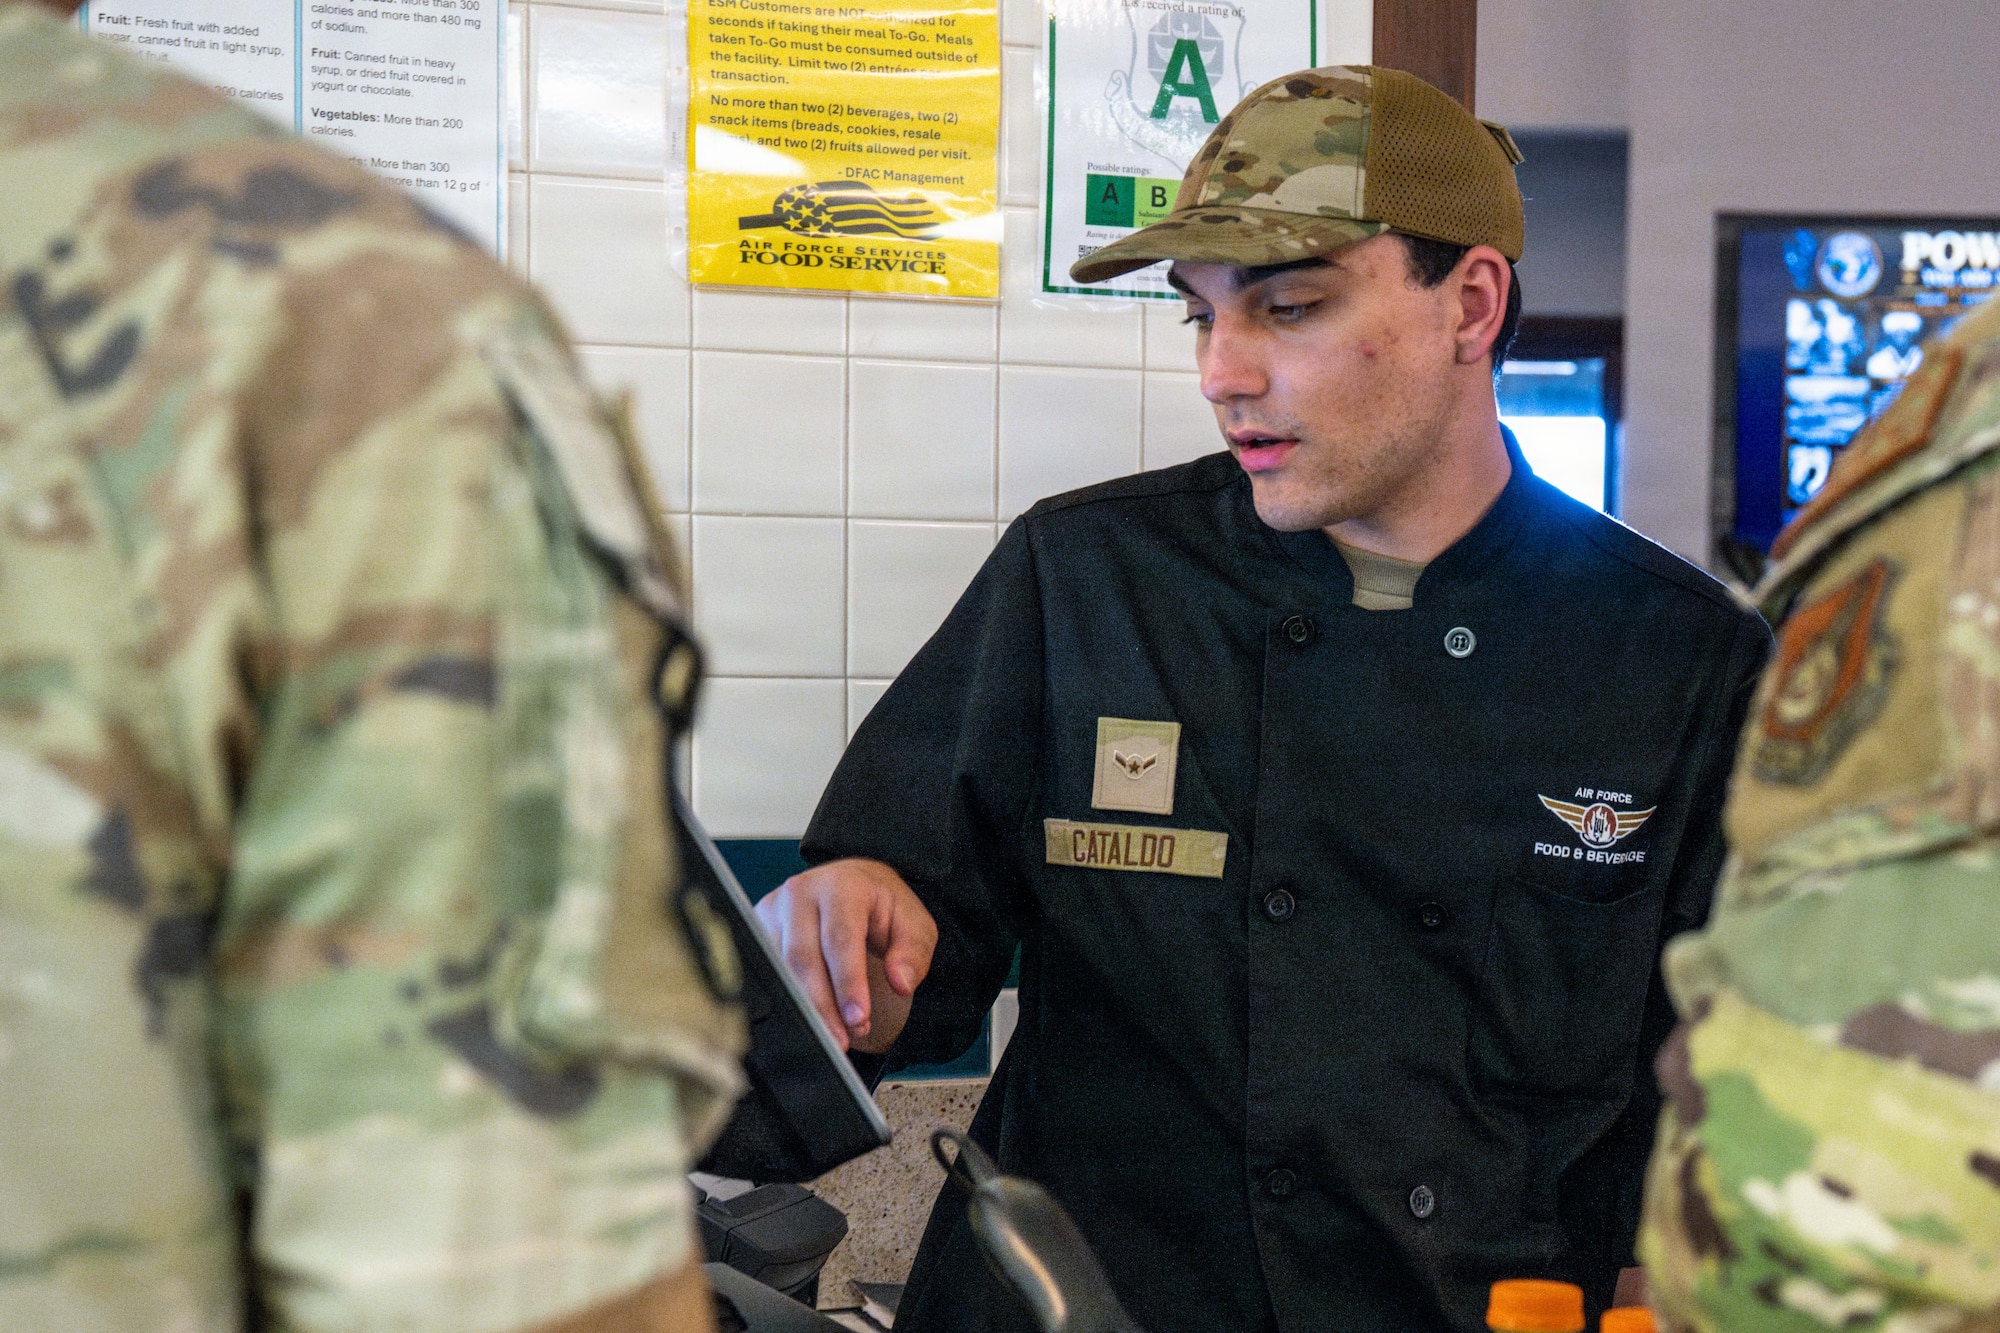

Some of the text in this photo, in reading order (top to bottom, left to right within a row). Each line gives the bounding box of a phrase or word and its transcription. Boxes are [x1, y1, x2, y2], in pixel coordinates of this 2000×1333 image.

[433, 0, 456, 8] than
[460, 1, 479, 10] 300
[709, 0, 736, 8] ESM
[740, 0, 811, 14] Customers
[815, 8, 835, 16] are
[839, 8, 865, 18] NOT
[939, 16, 956, 27] for
[1188, 5, 1194, 13] a
[1198, 6, 1228, 18] rating
[99, 13, 259, 36] Fruit: Fresh fruit with added
[311, 4, 481, 29] calories and more than 480 mg
[311, 20, 368, 34] of sodium.
[709, 16, 973, 46] seconds if taking their meal To-Go. Meals
[139, 34, 180, 46] canned
[184, 38, 205, 49] fruit
[209, 41, 219, 50] in
[223, 42, 246, 55] light
[250, 45, 284, 56] syrup.
[709, 33, 978, 63] taken To-Go must be consumed outside of
[312, 48, 455, 70] Fruit: Canned fruit in heavy
[710, 51, 731, 62] the
[734, 53, 782, 67] facility.
[789, 57, 820, 69] Limit
[823, 59, 848, 71] two
[851, 61, 866, 73] (2)
[311, 66, 342, 76] syrup,
[360, 69, 386, 79] dried
[390, 71, 409, 81] fruit
[412, 73, 453, 84] covered
[457, 77, 465, 85] in
[711, 69, 789, 85] transaction.
[1151, 39, 1220, 123] A
[239, 89, 284, 101] calories
[311, 81, 414, 97] yogurt or chocolate.
[311, 108, 463, 129] Vegetables: More than 200
[710, 94, 958, 125] No more than two (2) beverages, two (2)
[311, 125, 357, 137] calories.
[710, 114, 941, 140] snack items (breads, cookies, resale
[757, 136, 781, 147] and
[784, 137, 807, 149] two
[811, 138, 826, 152] (2)
[830, 140, 863, 152] fruits
[866, 143, 915, 156] allowed
[919, 147, 939, 160] per
[942, 148, 971, 160] visit.
[371, 158, 399, 168] More
[402, 161, 426, 170] than
[430, 162, 450, 172] 300
[1087, 162, 1152, 175] Possible ratings:
[416, 178, 439, 188] than
[444, 179, 457, 189] 12
[460, 182, 466, 191] g
[470, 181, 480, 191] of
[846, 167, 880, 180] DFAC
[883, 170, 964, 185] Management
[1102, 182, 1167, 207] A B
[739, 239, 946, 259] AIR FORCE SERVICES
[740, 250, 946, 275] FOOD SERVICE
[1575, 787, 1632, 804] AIR FORCE
[1073, 829, 1175, 868] CATALDO
[1534, 842, 1570, 857] FOOD
[1574, 849, 1583, 859] &
